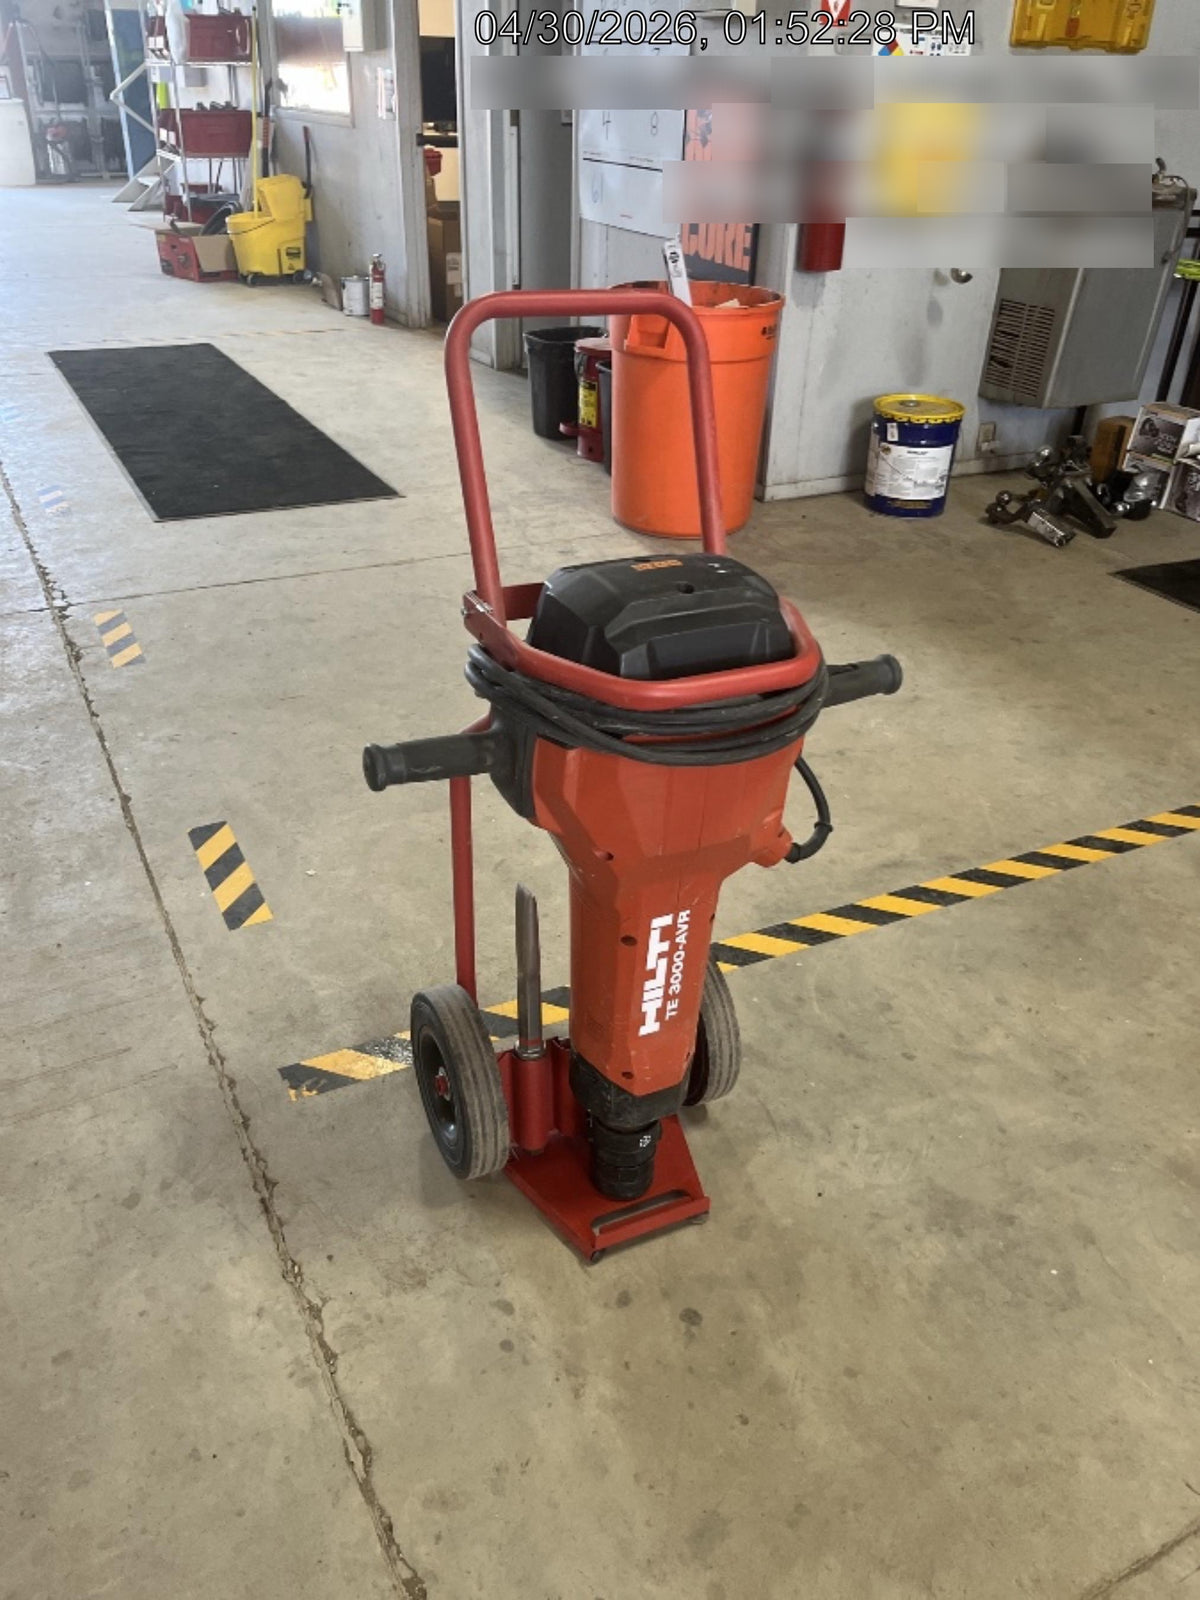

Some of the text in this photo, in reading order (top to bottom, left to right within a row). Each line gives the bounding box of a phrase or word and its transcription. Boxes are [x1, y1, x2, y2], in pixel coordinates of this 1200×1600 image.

[638, 913, 674, 1036] HILTI
[665, 909, 691, 1020] TE 3000-AVR
